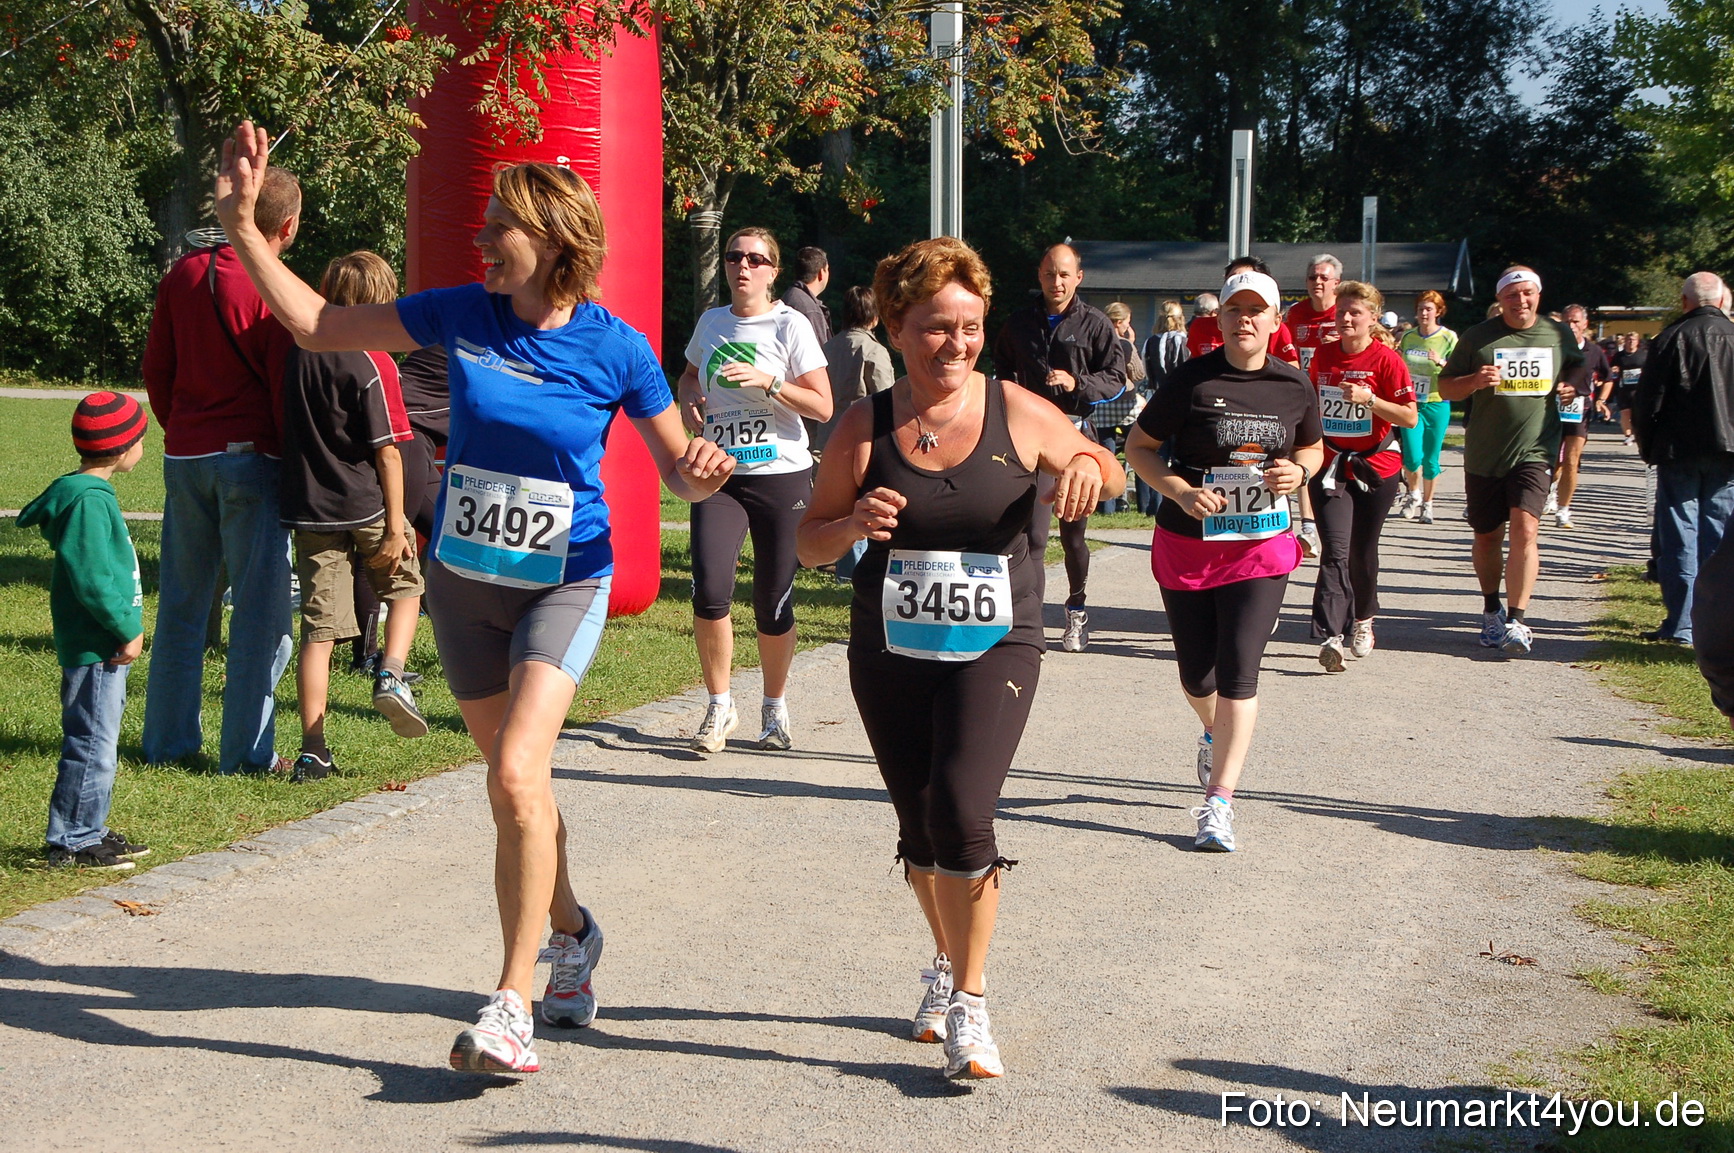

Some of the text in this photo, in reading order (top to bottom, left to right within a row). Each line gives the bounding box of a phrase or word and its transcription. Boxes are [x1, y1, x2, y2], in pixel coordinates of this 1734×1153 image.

[1508, 360, 1540, 378] 565
[1411, 380, 1426, 393] 11
[1504, 380, 1543, 390] Michael
[714, 410, 742, 419] PFLEIDERER
[1323, 399, 1365, 420] 2276
[713, 419, 768, 448] 2152
[1325, 420, 1362, 431] Daniela
[465, 476, 516, 495] PFLEIDERER
[455, 496, 555, 551] 3492
[1213, 513, 1281, 533] May-Britt
[903, 560, 956, 572] PFLEIDERER
[896, 579, 997, 623] 3456
